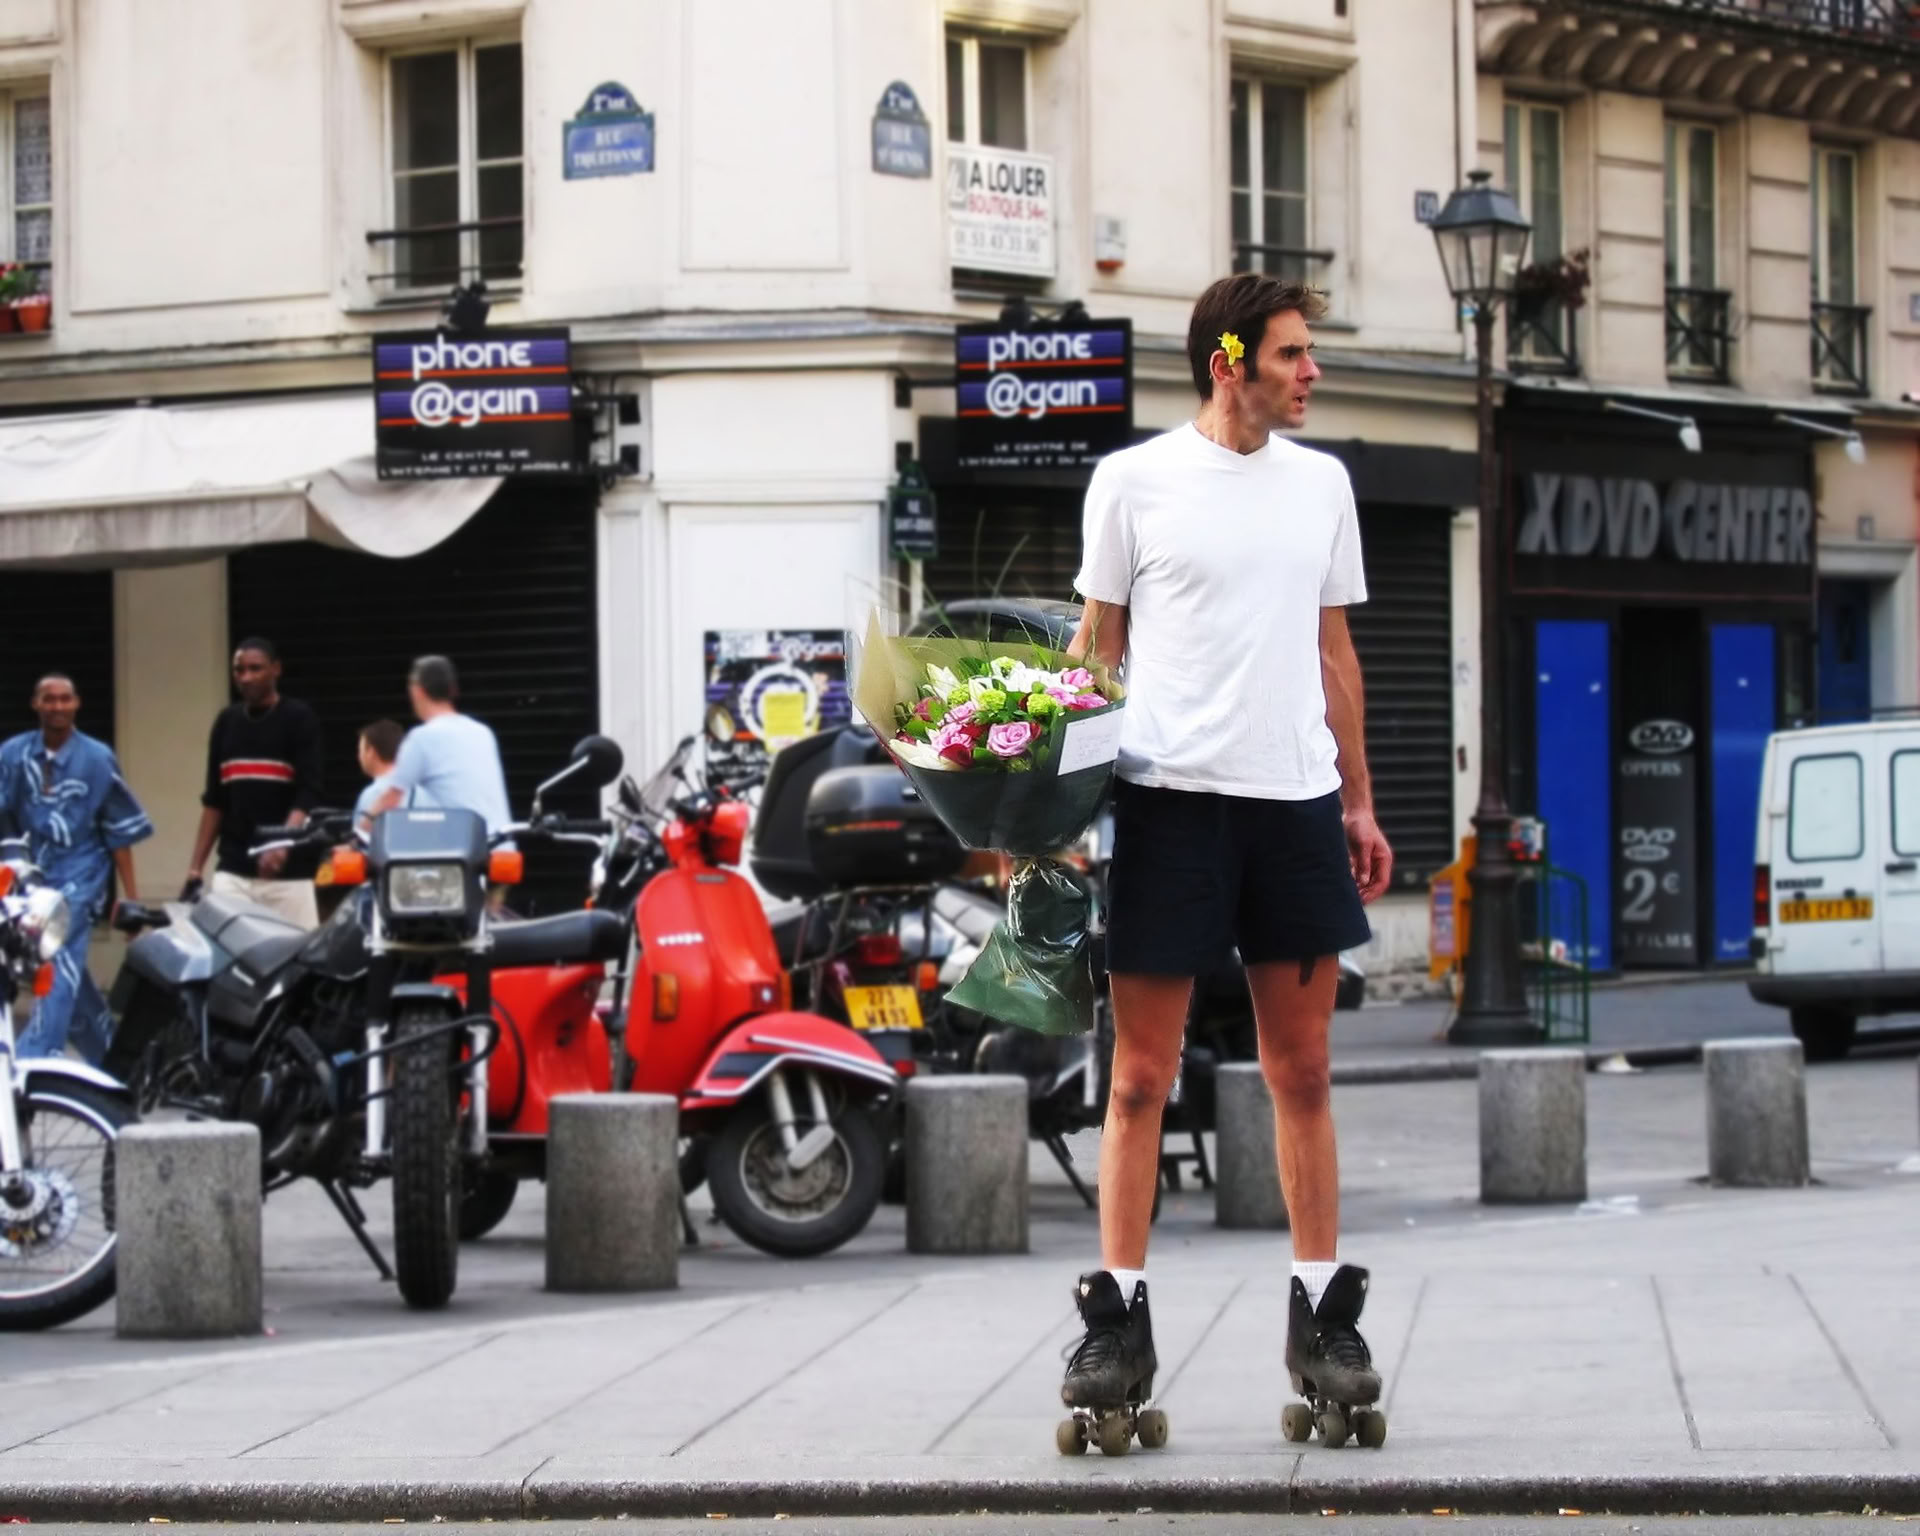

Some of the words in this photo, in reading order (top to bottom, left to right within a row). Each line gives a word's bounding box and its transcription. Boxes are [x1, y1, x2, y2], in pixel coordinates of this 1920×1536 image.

[969, 160, 984, 189] A
[988, 162, 1047, 198] LOUER
[968, 194, 1024, 220] BOUTIQUE
[412, 333, 532, 380] phone
[988, 331, 1093, 372] phone
[411, 382, 539, 427] @gain
[985, 373, 1097, 419] @gain
[510, 449, 530, 459] DE
[1517, 472, 1562, 555] X
[1563, 475, 1660, 559] DVD
[1667, 481, 1811, 563] CENTER
[1639, 725, 1689, 743] DVD
[1621, 827, 1676, 846] DVD
[1636, 934, 1692, 948] FILMS
